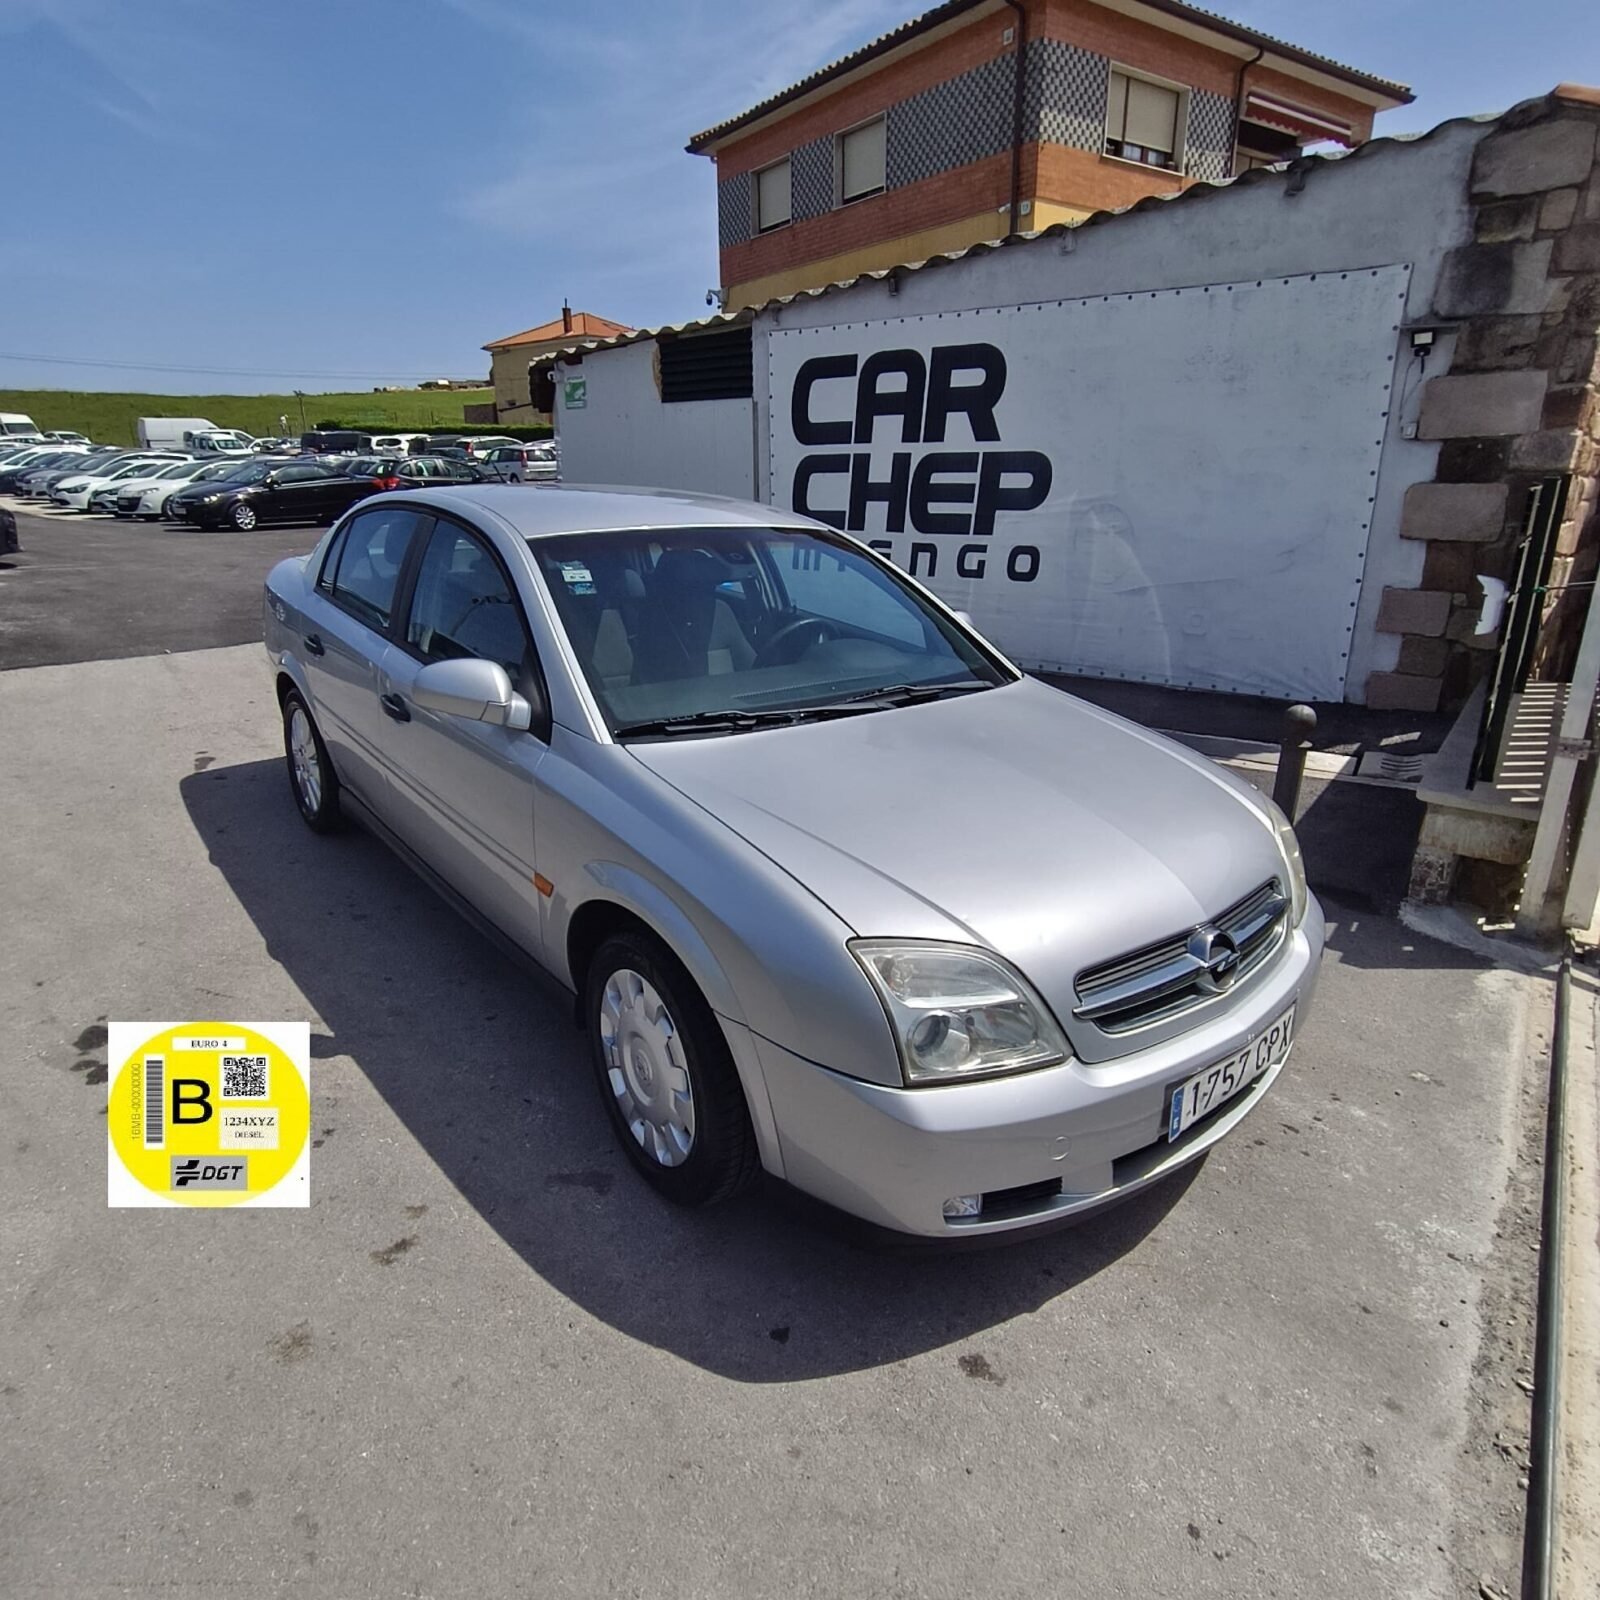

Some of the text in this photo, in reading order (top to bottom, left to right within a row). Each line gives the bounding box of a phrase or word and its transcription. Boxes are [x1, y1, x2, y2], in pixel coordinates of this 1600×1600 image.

[791, 343, 1007, 445] CAR
[792, 451, 1052, 535] CHEP
[1192, 1014, 1291, 1117] 1757 CPX
